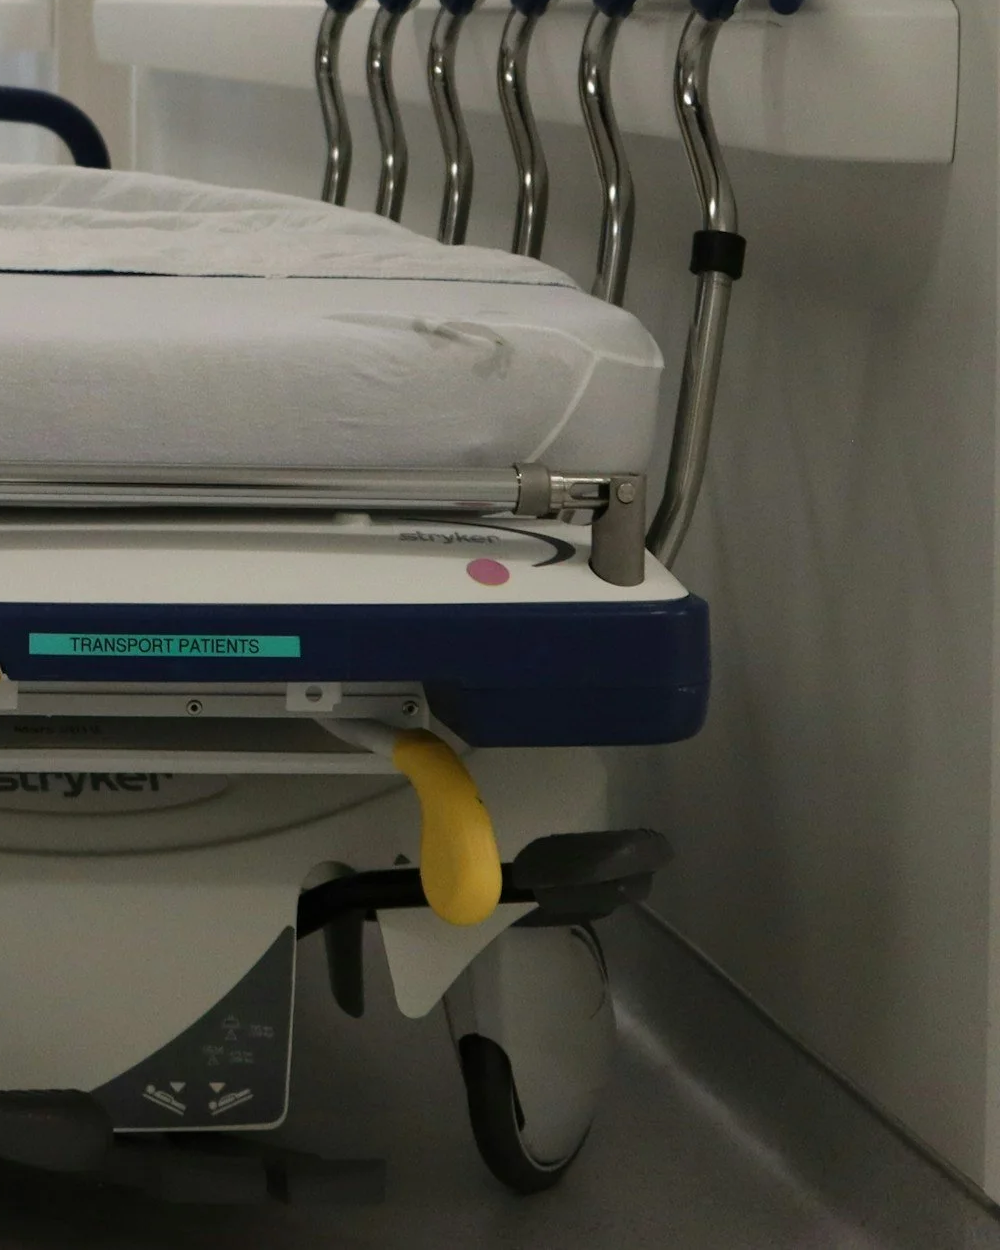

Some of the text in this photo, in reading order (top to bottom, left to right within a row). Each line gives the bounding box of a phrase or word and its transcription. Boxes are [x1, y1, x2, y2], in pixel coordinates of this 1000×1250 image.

[398, 530, 501, 545] stryker
[71, 636, 261, 655] TRANSPORT PATIENTS
